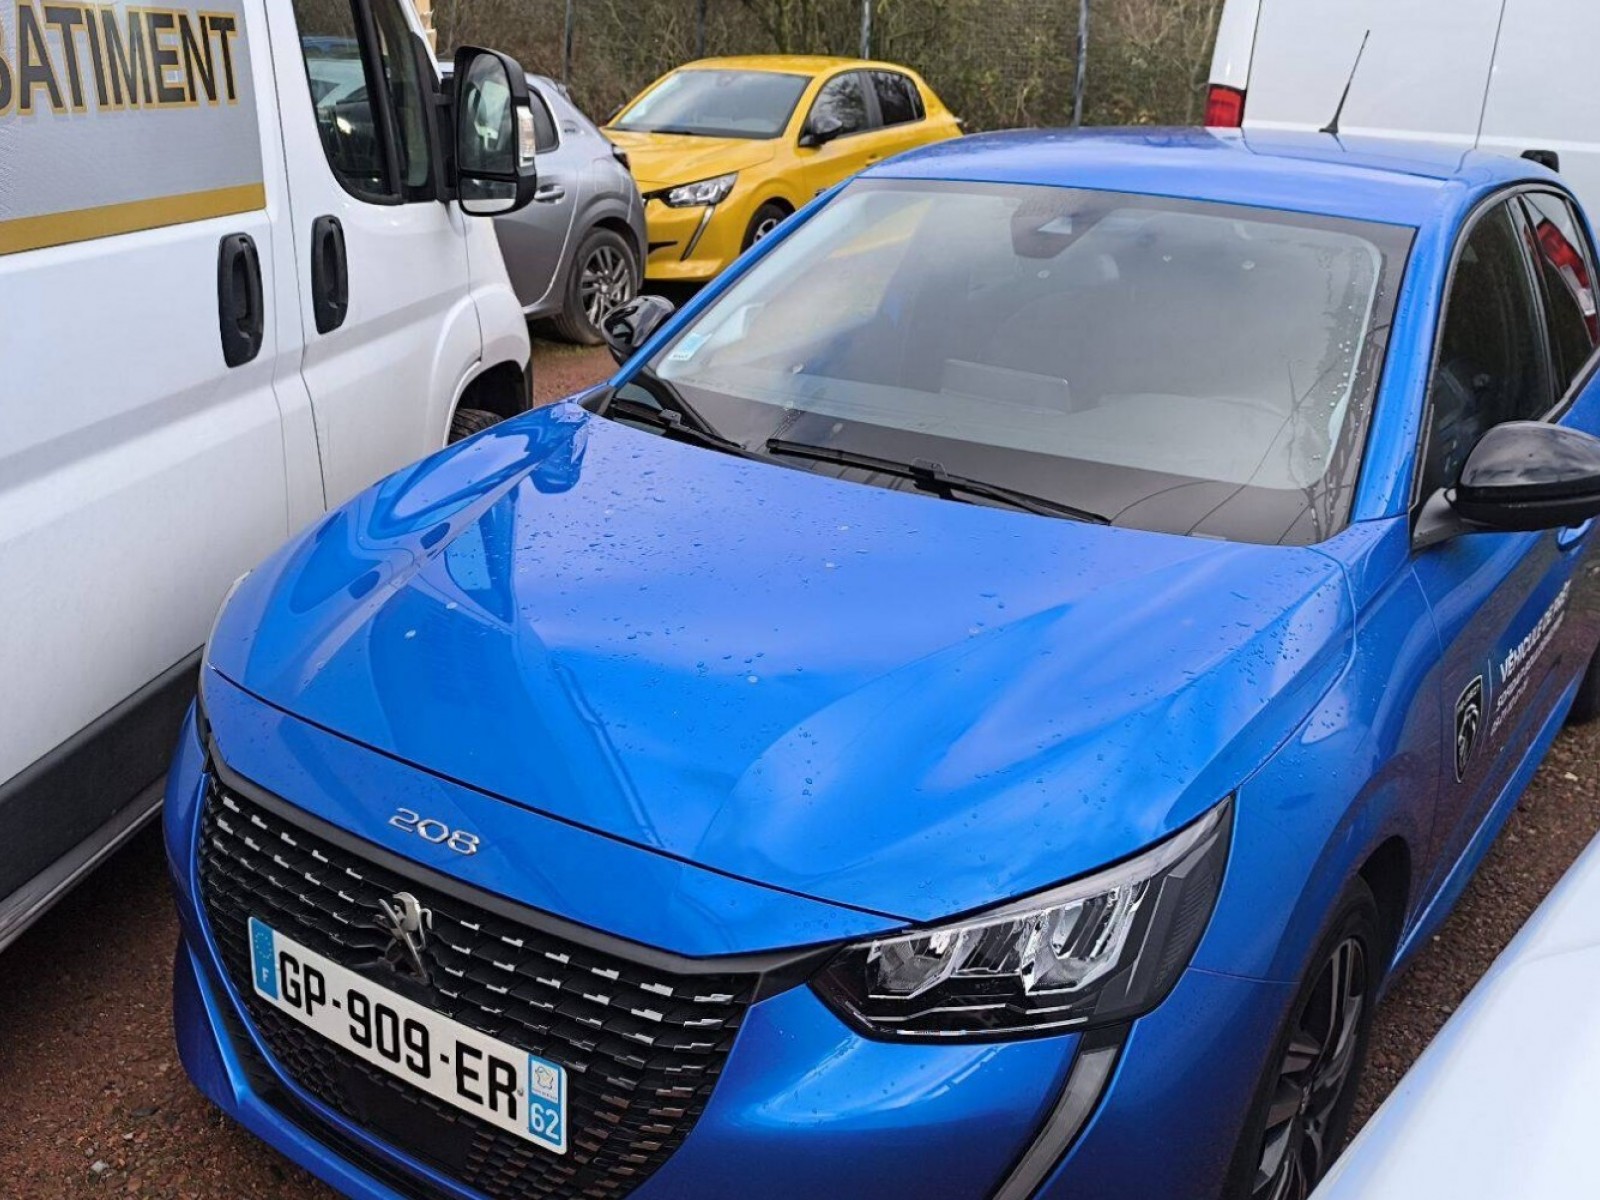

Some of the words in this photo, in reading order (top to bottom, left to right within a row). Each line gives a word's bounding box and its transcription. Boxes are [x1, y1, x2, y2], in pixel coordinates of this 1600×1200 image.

[0, 2, 237, 113] ATIMENT
[389, 807, 480, 855] 208
[262, 966, 270, 983] F
[279, 951, 517, 1120] GP-909-ER
[530, 1102, 560, 1140] 62
